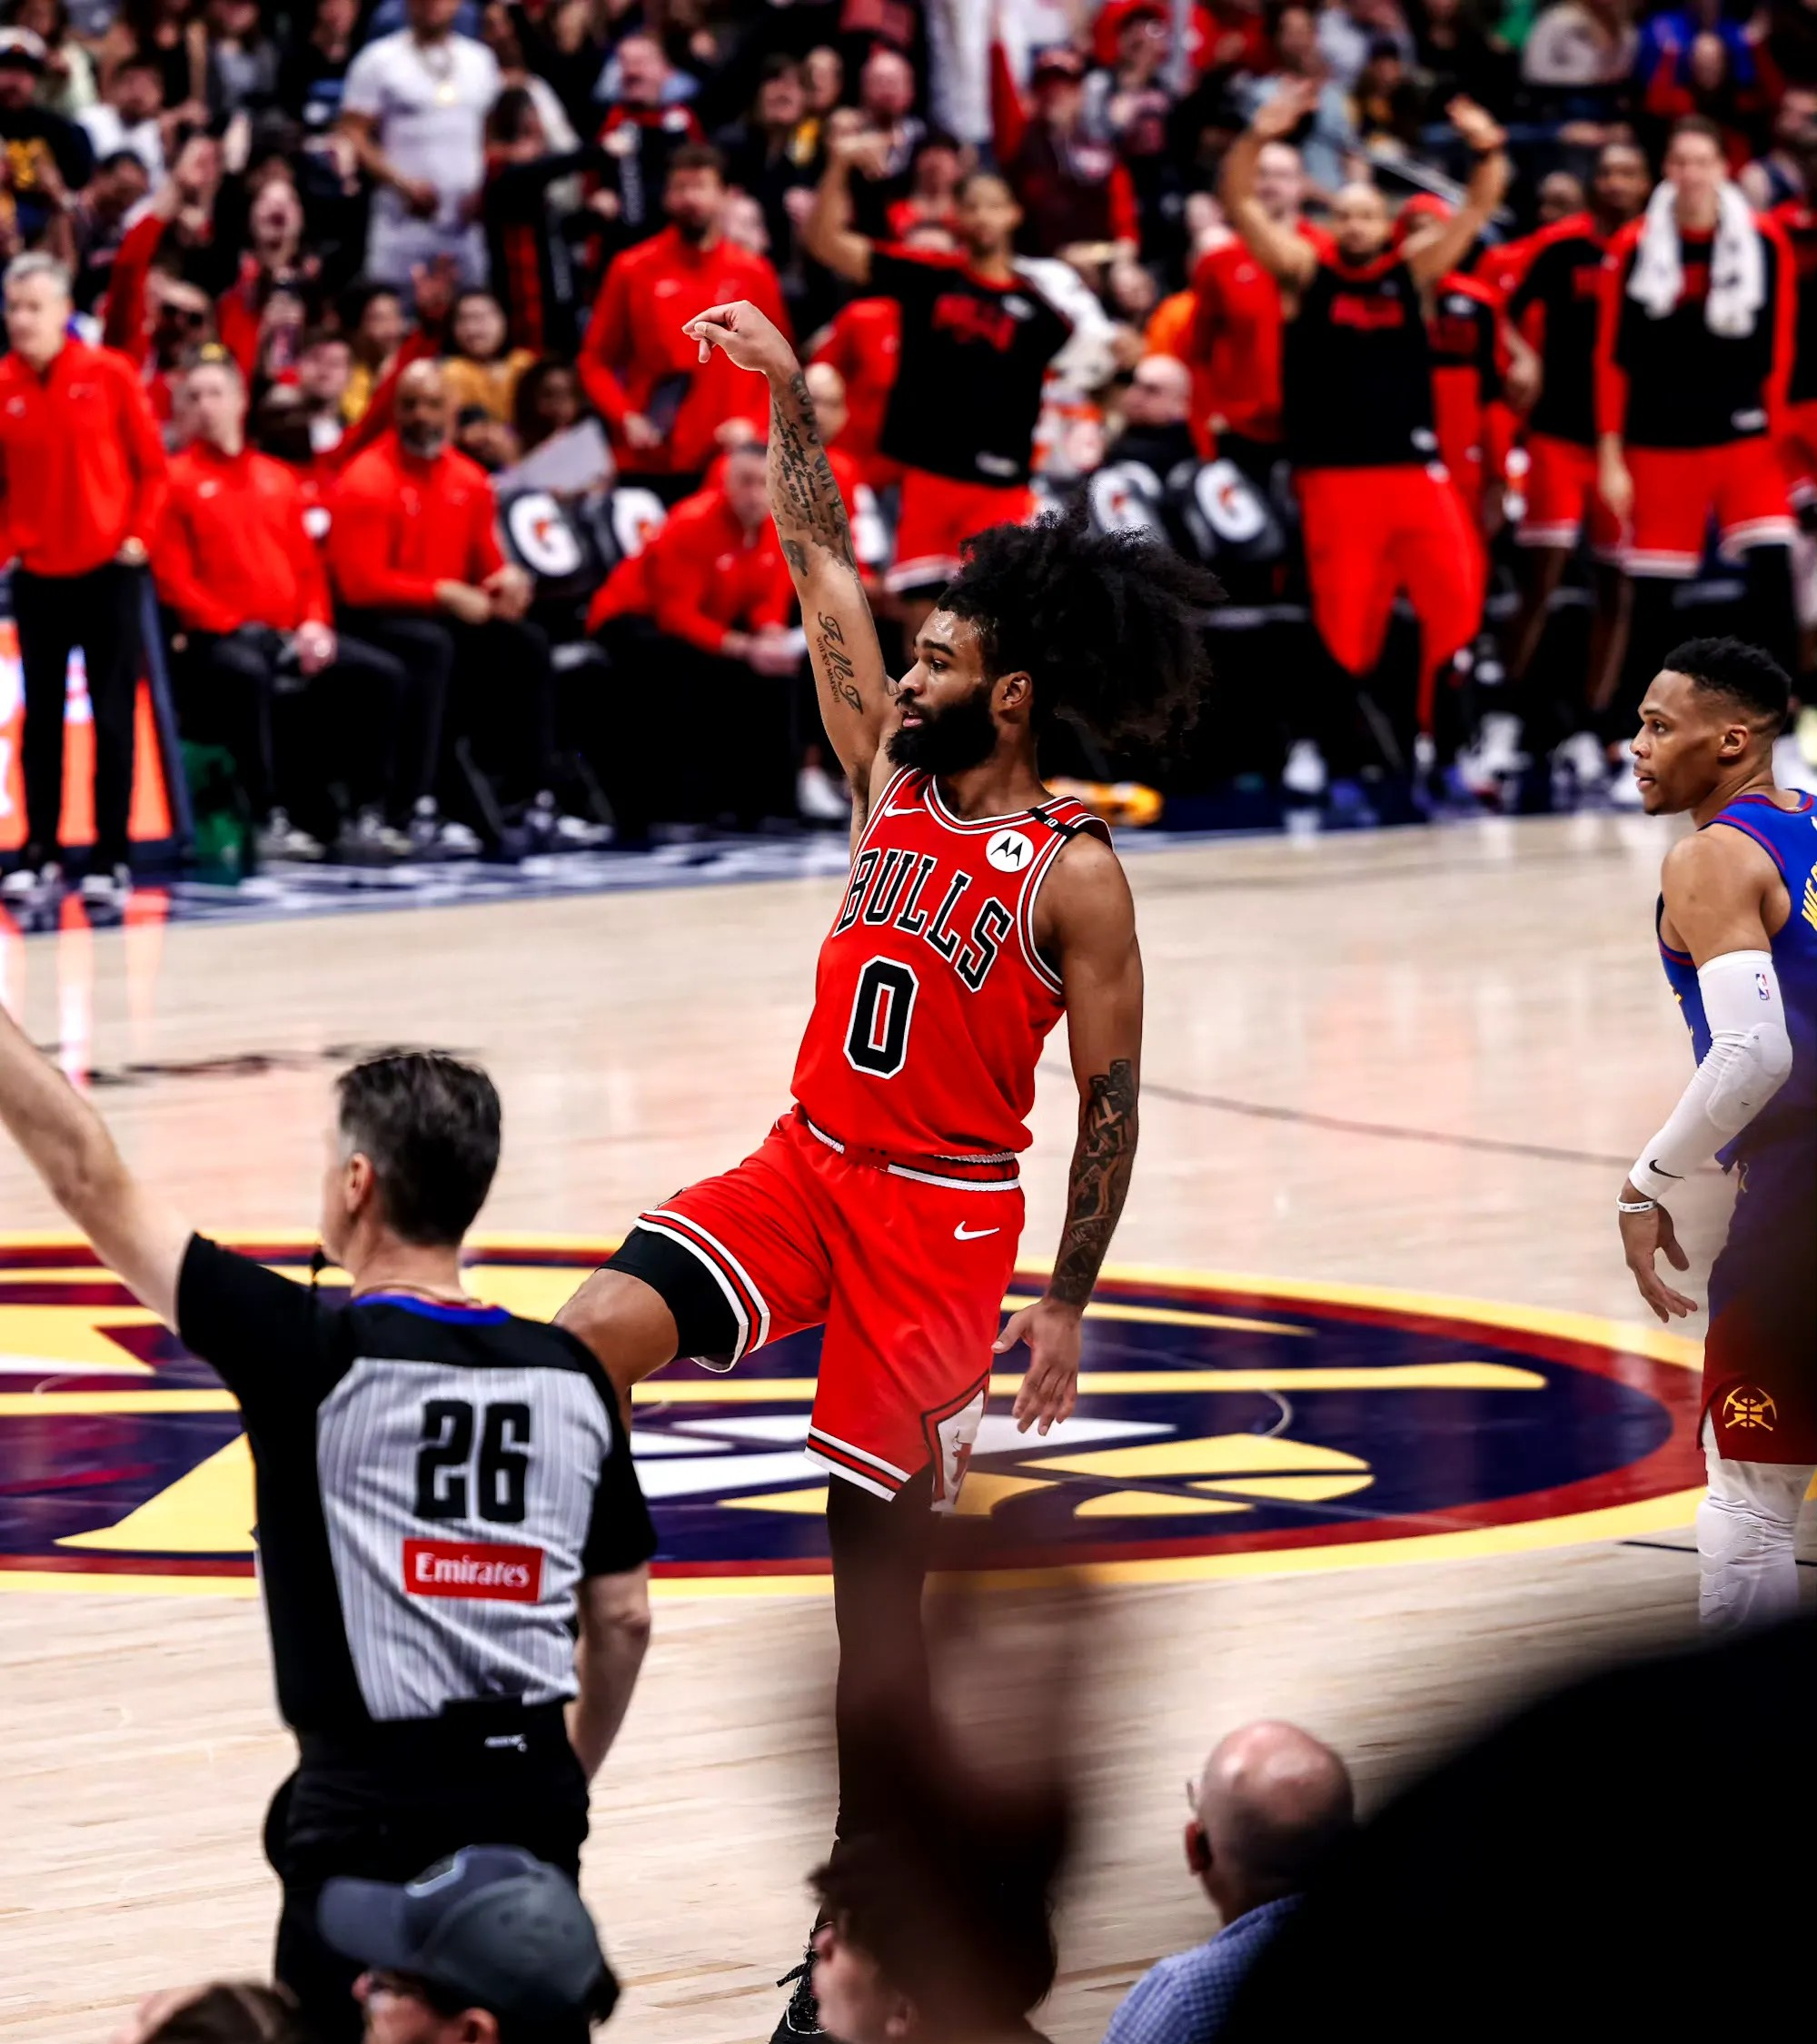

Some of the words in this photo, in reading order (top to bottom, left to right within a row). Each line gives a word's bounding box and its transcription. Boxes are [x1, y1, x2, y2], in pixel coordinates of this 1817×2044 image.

[1044, 818, 1058, 829] 10
[832, 847, 1015, 993] BULLS
[843, 955, 919, 1079] 0
[413, 1399, 531, 1523] 26
[415, 1552, 531, 1588] Emirates
